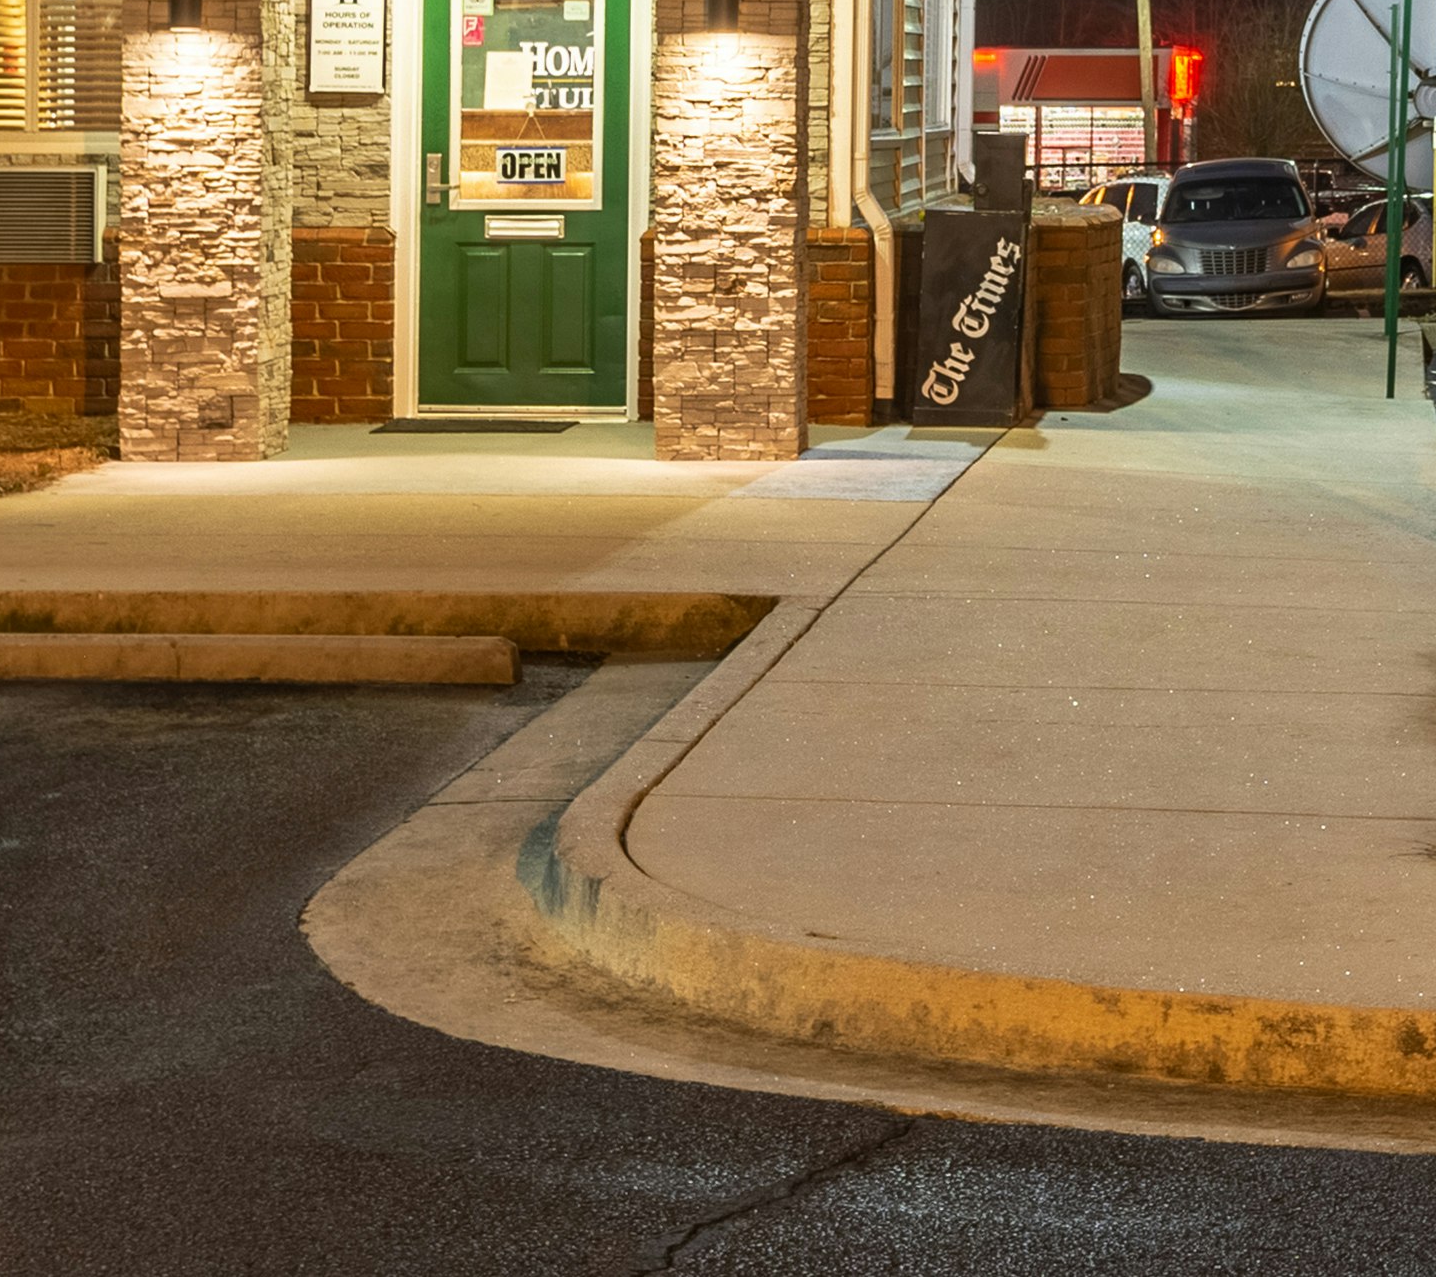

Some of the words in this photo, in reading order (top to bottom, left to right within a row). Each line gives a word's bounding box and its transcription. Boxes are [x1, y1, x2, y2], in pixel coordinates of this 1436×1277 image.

[501, 152, 561, 179] OPEN
[921, 341, 976, 406] The
[952, 236, 1021, 339] Times
